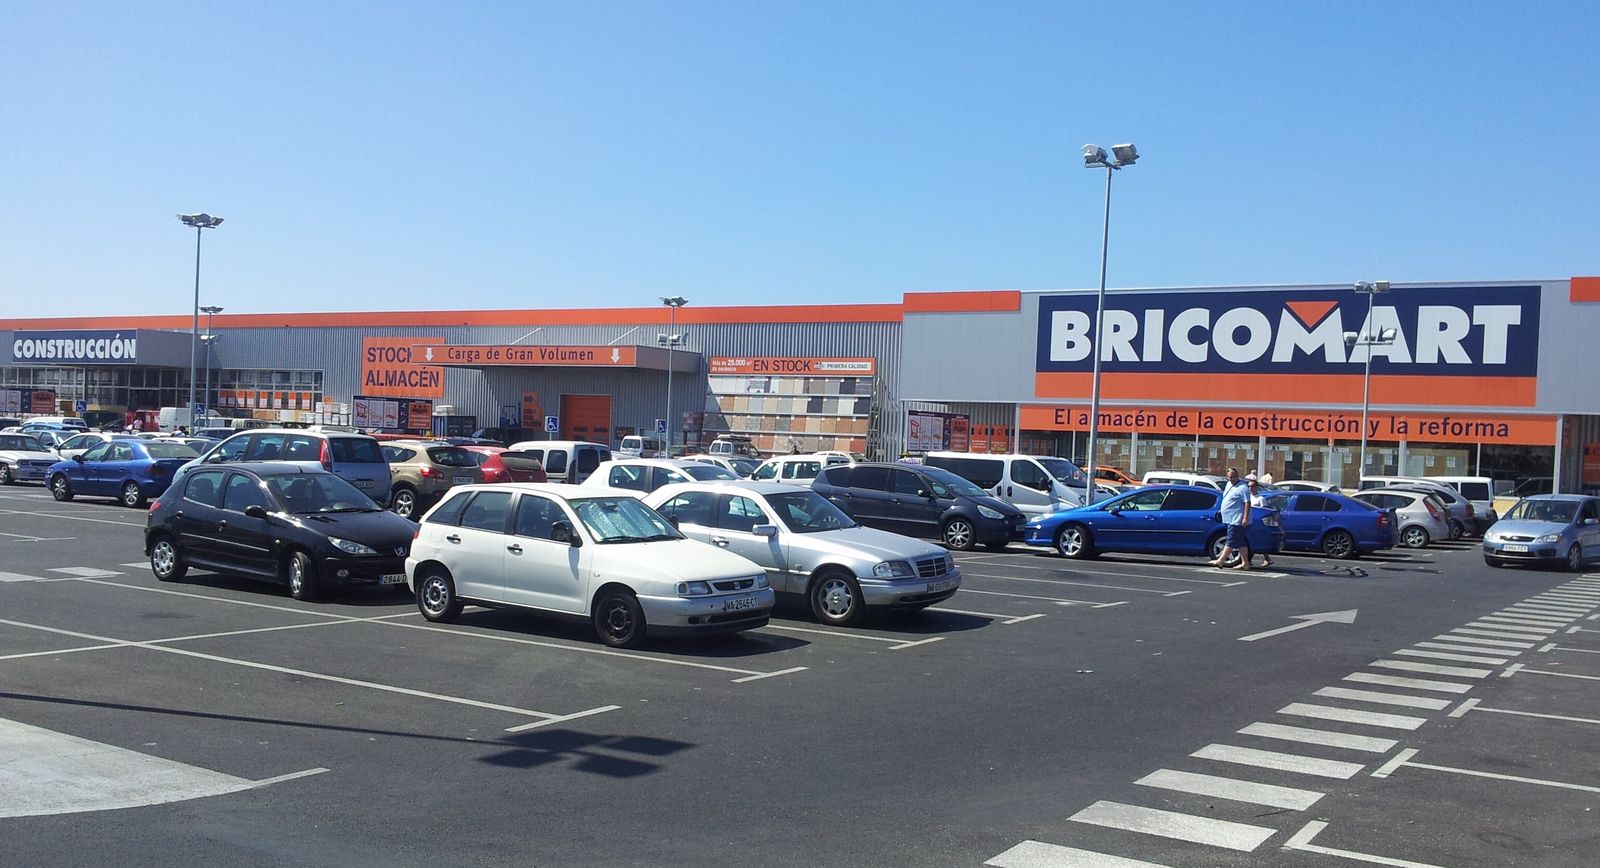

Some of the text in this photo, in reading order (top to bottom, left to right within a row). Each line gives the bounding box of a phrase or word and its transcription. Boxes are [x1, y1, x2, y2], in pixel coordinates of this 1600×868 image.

[13, 333, 136, 359] CONSTRUCCIÓN
[1050, 305, 1522, 365] BRICOMART
[448, 348, 594, 363] Carga de Gran Volumen
[753, 359, 812, 371] EN STOCK
[365, 366, 440, 388] ALMACÉN
[1054, 408, 1510, 437] El amacén de la construcción y la reforma
